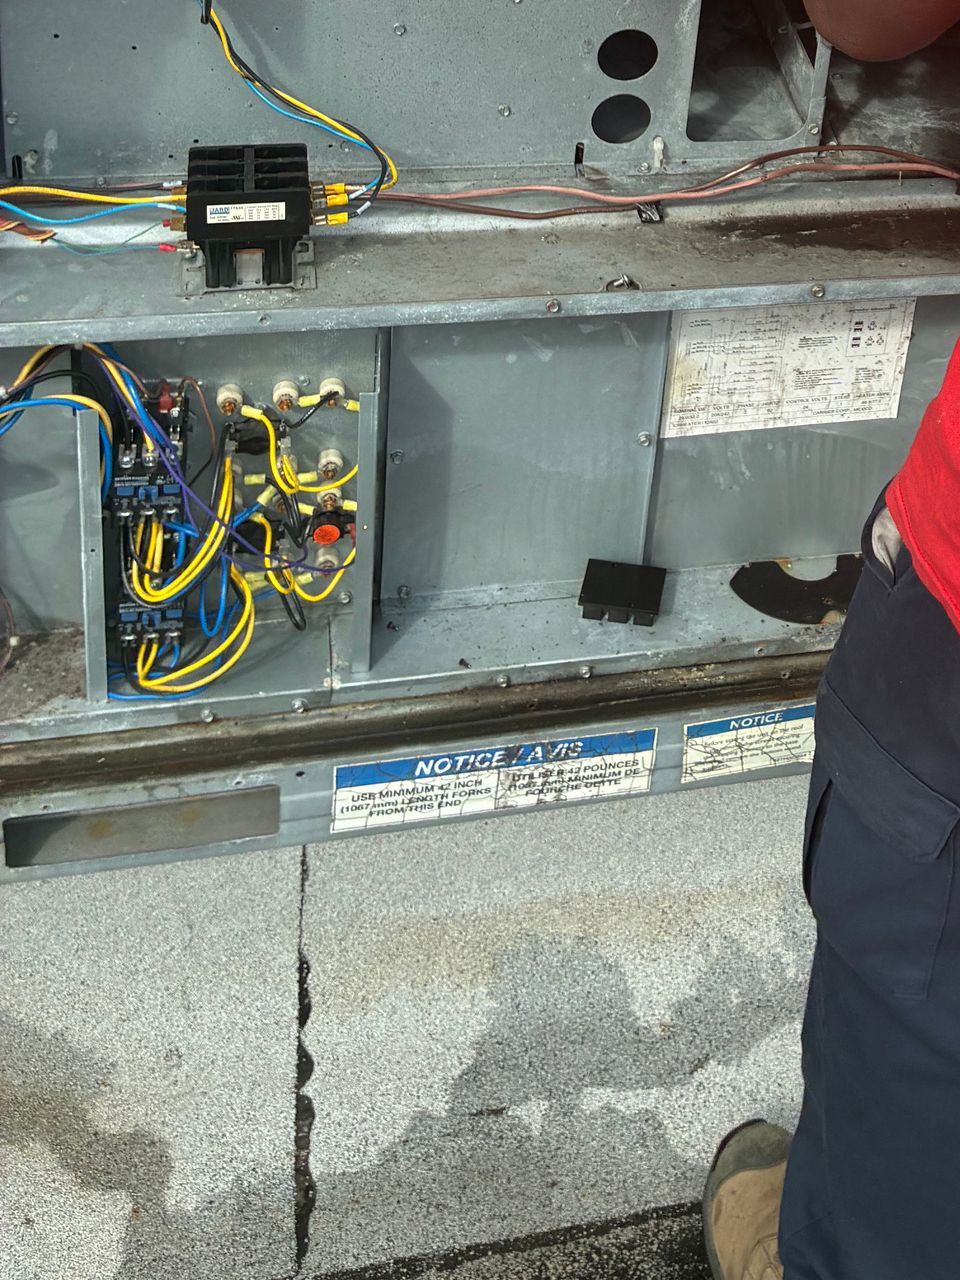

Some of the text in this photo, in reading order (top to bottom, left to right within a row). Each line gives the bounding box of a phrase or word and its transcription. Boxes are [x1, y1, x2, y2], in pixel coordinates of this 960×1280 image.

[730, 713, 783, 730] NOTICE
[415, 751, 505, 777] NOTICE
[583, 759, 640, 773] POUNCES
[568, 770, 622, 782] MINIMUM
[624, 767, 641, 777] DE
[352, 793, 376, 803] USE
[379, 785, 435, 799] MINIMUM
[454, 779, 483, 789] INCH
[401, 793, 449, 805] LENGTH
[452, 788, 492, 798] FORKS
[369, 799, 462, 817] FROM THIS END
